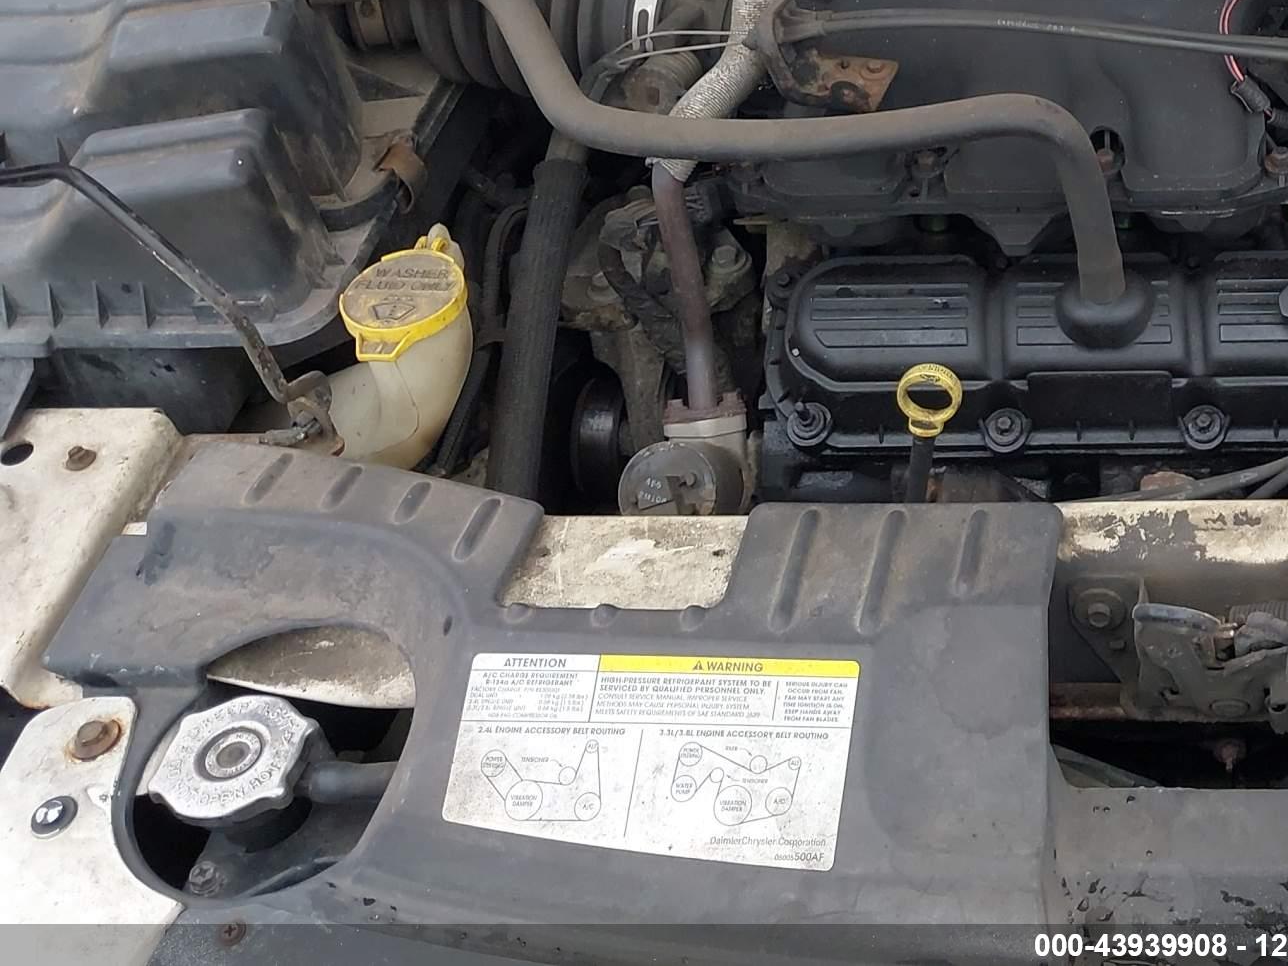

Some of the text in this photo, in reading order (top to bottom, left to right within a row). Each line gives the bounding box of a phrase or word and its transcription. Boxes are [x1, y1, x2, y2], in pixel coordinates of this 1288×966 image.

[376, 268, 449, 280] WASHER
[354, 280, 457, 291] FLUID ONLY
[504, 658, 566, 668] ATTENTION
[706, 661, 764, 672] WARNING
[601, 676, 660, 684] HIGH-PRESSURE
[663, 678, 715, 686] REFRIGERANT
[600, 684, 638, 692] SERVICED
[653, 685, 692, 693] QUALIFIED
[743, 687, 765, 695] ONLY.
[478, 726, 625, 735] 2.4L ENGINE ACCESSORY BELT ROUTING
[696, 730, 725, 738] ENGINE
[726, 730, 773, 739] ACCESSORY
[775, 731, 791, 739] BELT
[794, 732, 829, 740] ROUTING
[710, 836, 826, 848] DaimlerChrysler Corporation
